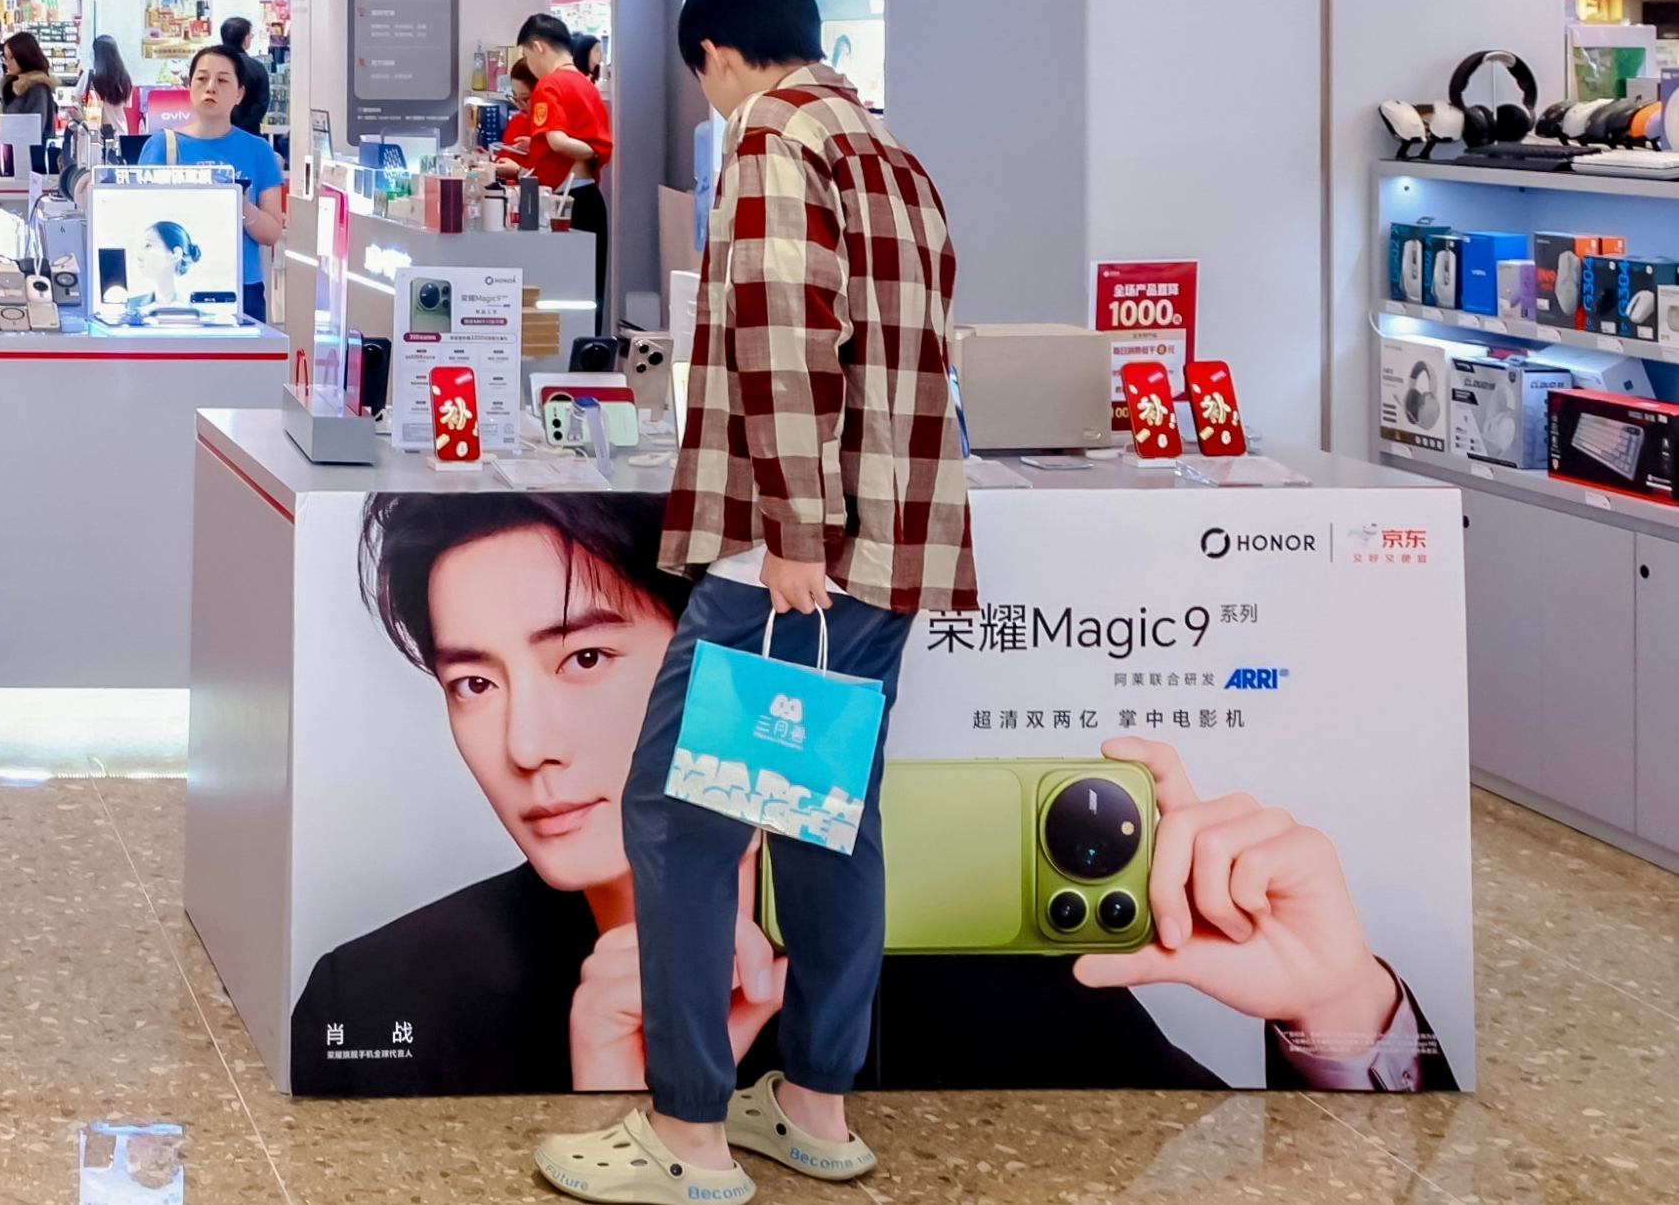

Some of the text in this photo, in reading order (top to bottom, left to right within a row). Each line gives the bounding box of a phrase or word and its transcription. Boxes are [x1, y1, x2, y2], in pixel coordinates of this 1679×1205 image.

[1113, 282, 1180, 298] 全场产品直降
[1582, 256, 1595, 313] G304
[1237, 535, 1316, 551] HONOR
[1381, 530, 1427, 549] 京东
[1352, 553, 1427, 563] 又好又便宜
[1219, 603, 1258, 624] 系列
[1114, 668, 1278, 690] 阿莱联合研发 ARRI
[972, 709, 1245, 729] 超清双两亿 掌中电影机
[327, 1049, 413, 1059] 荣耀旗舰手机全球代言人
[790, 1146, 853, 1169] Become
[545, 1164, 589, 1192] Future
